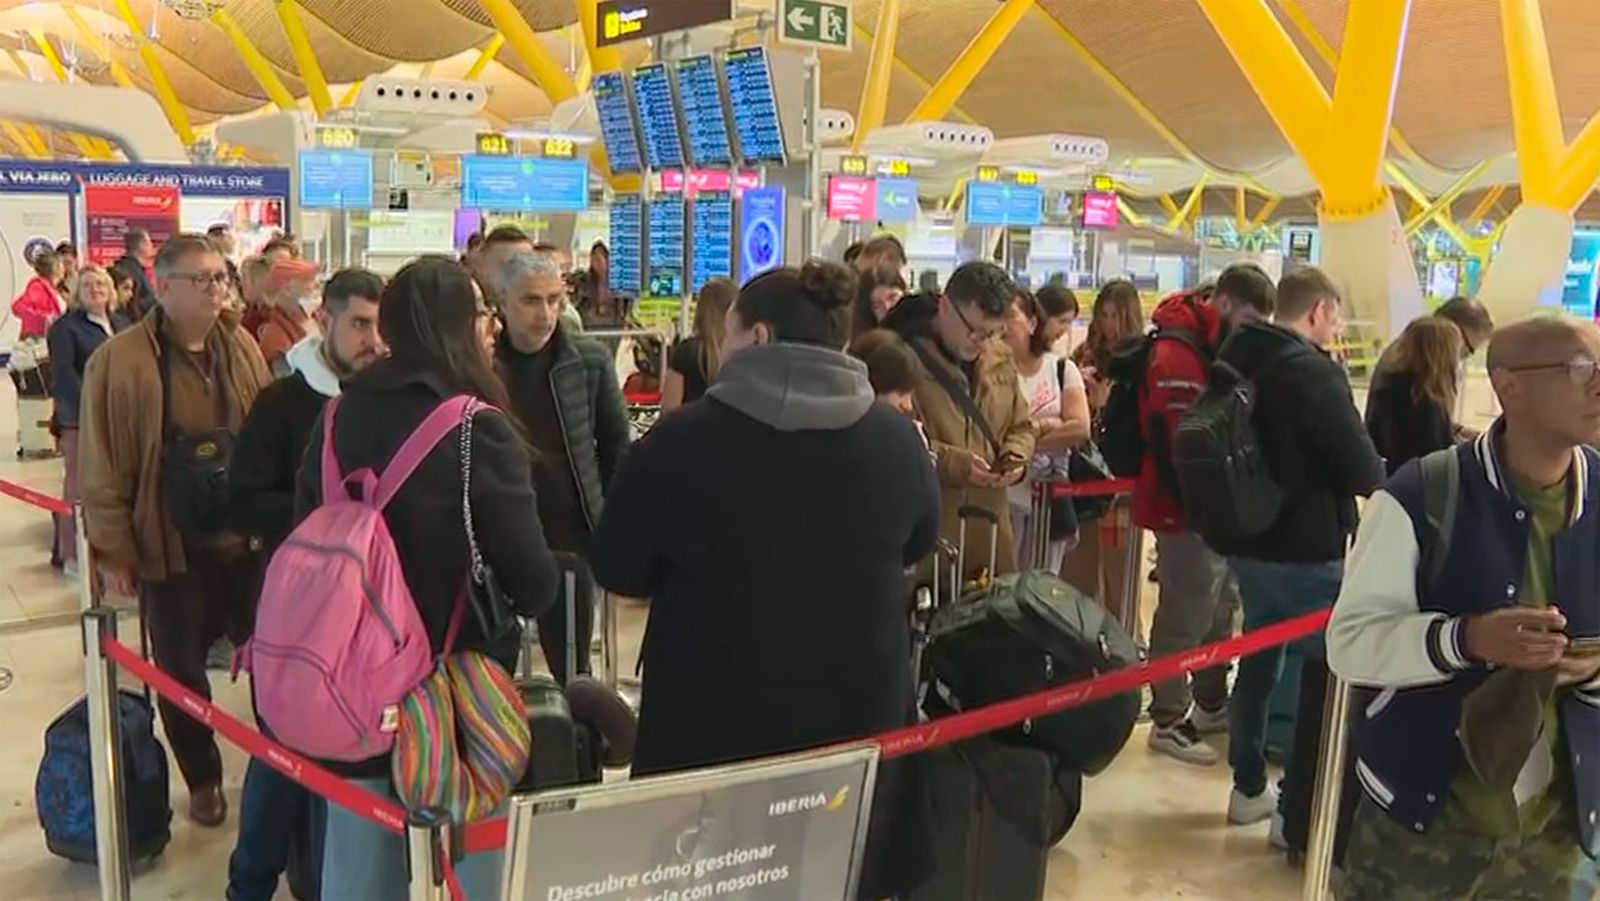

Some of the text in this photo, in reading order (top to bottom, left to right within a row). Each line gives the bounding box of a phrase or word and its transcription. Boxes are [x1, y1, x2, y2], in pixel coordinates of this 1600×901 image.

[90, 173, 264, 188] LUGGAGE AND TRAVEL STORE
[768, 792, 826, 816] IBERIA
[548, 873, 638, 901] Descubre
[642, 864, 691, 885] cómo
[694, 844, 776, 878] gestionar
[681, 883, 713, 900] con
[716, 865, 788, 894] nosotros
